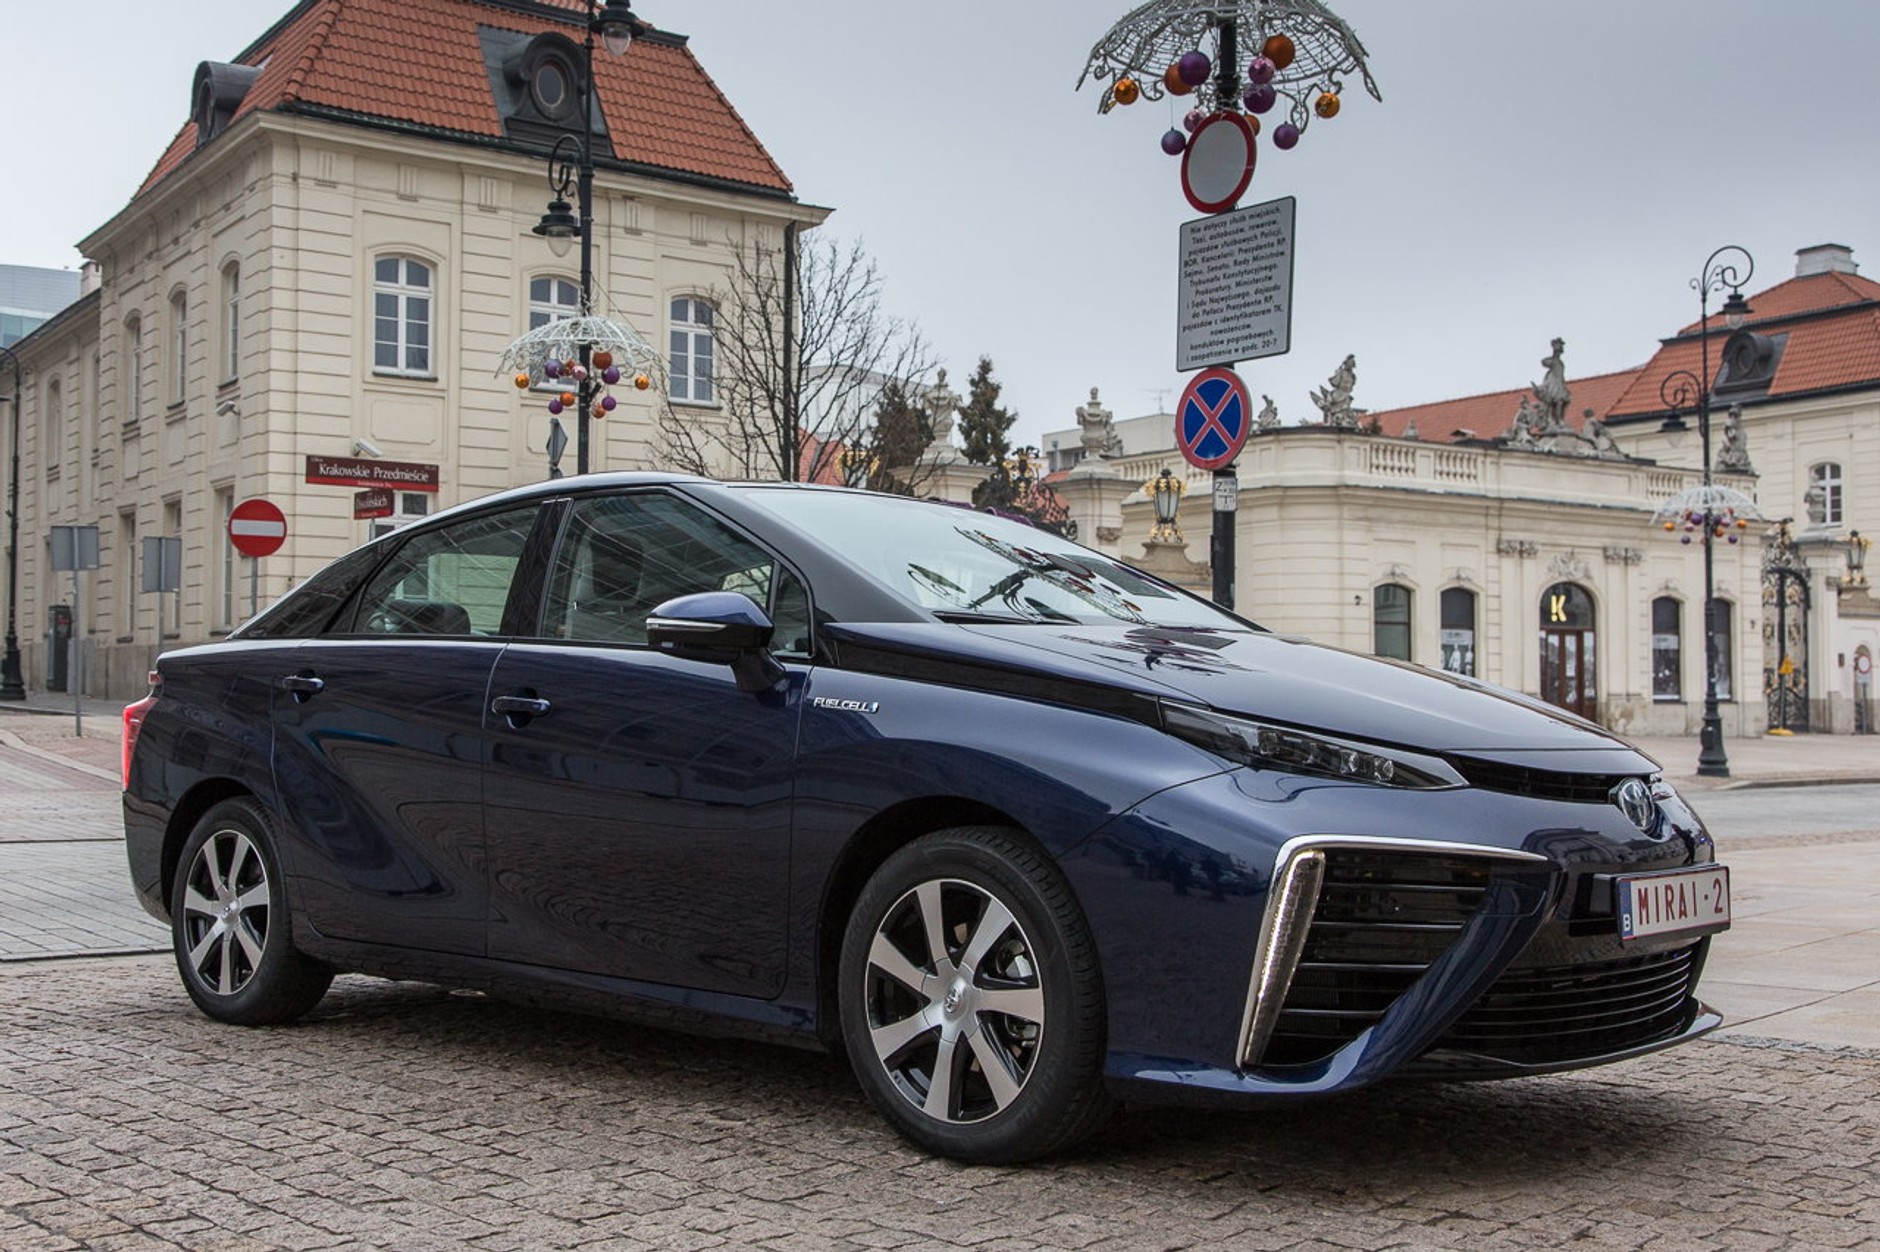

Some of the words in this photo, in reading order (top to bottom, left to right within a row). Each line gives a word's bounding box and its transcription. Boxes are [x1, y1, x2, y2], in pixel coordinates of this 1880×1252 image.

[1238, 241, 1274, 254] Prezydenta
[1233, 257, 1249, 266] Rady
[1225, 298, 1261, 311] Prezydenta
[319, 463, 371, 478] Krakowskie
[374, 466, 429, 483] Przedmieście
[814, 697, 842, 710] FUEL
[842, 700, 870, 712] CELL
[1622, 913, 1632, 932] B
